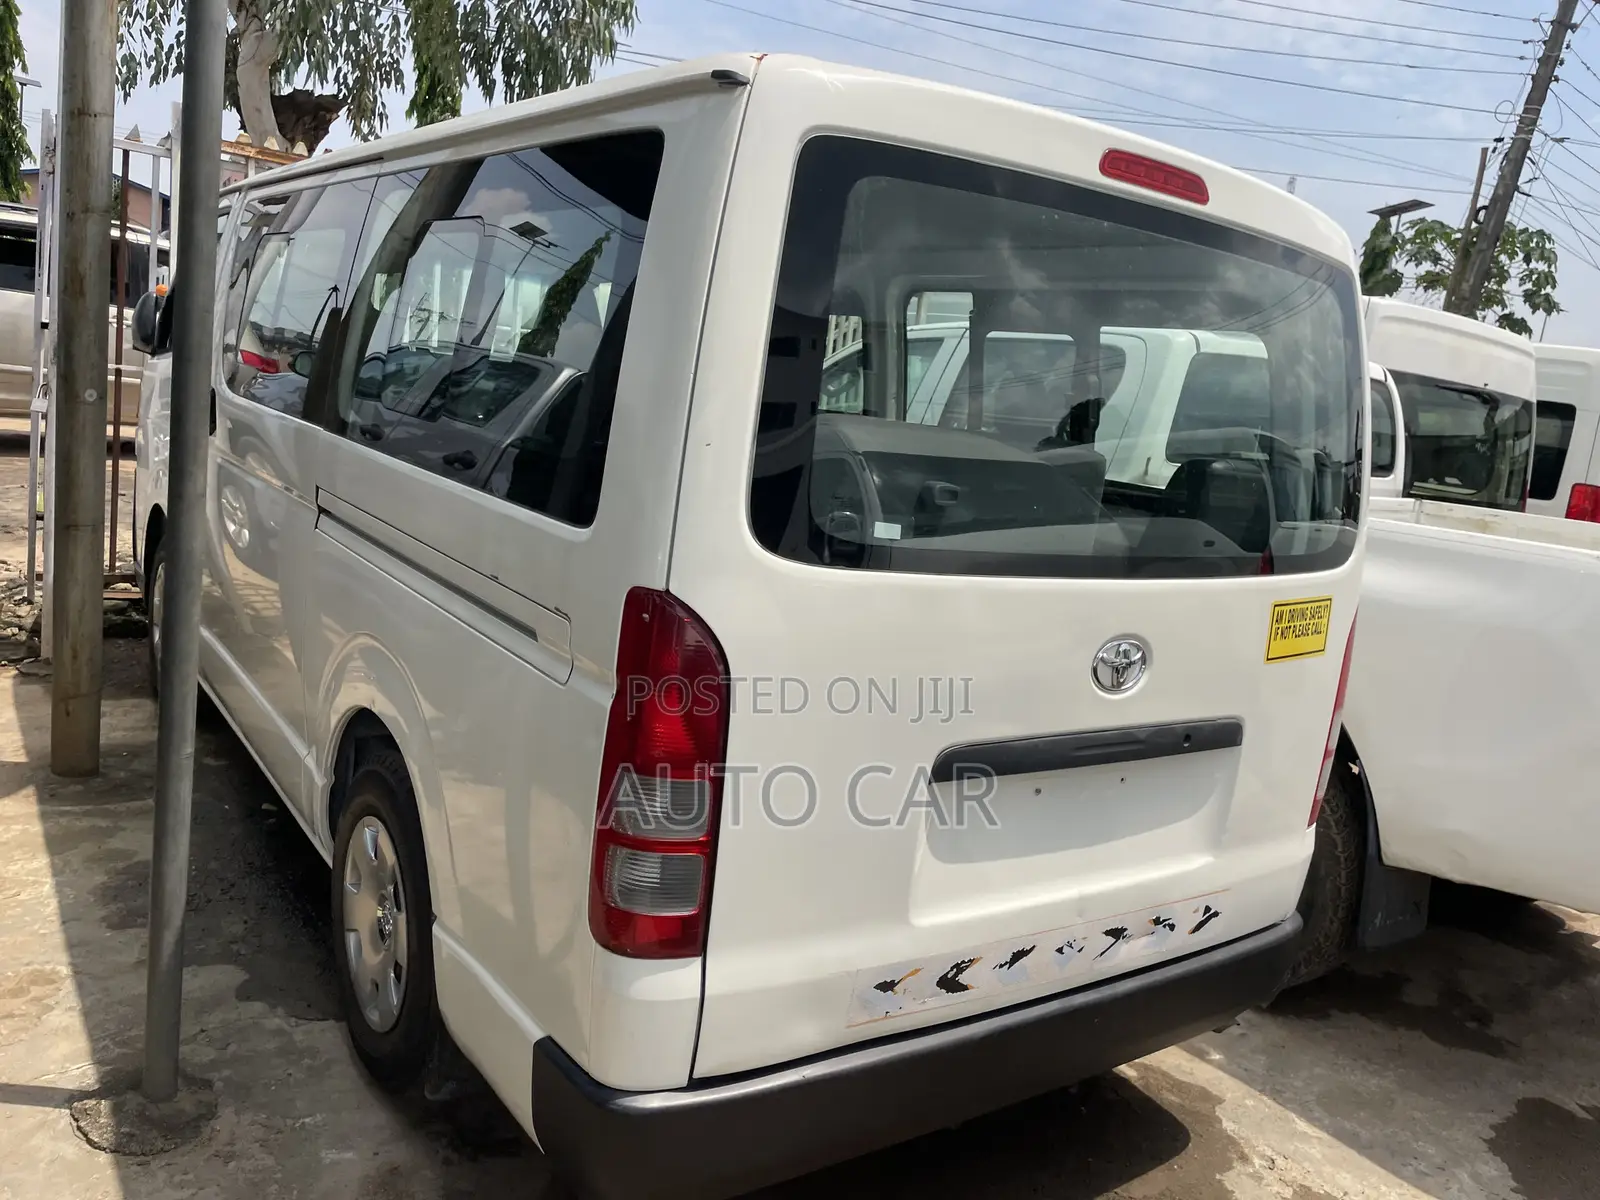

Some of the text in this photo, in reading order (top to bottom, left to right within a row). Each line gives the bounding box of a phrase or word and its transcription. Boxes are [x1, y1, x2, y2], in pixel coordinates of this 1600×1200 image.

[1275, 609, 1285, 625] AM
[1287, 607, 1309, 624] DRIVING
[1309, 604, 1329, 620] SAFELY?
[1273, 626, 1280, 641] IF
[1279, 624, 1292, 641] NOT
[1291, 623, 1311, 639] PLEASE
